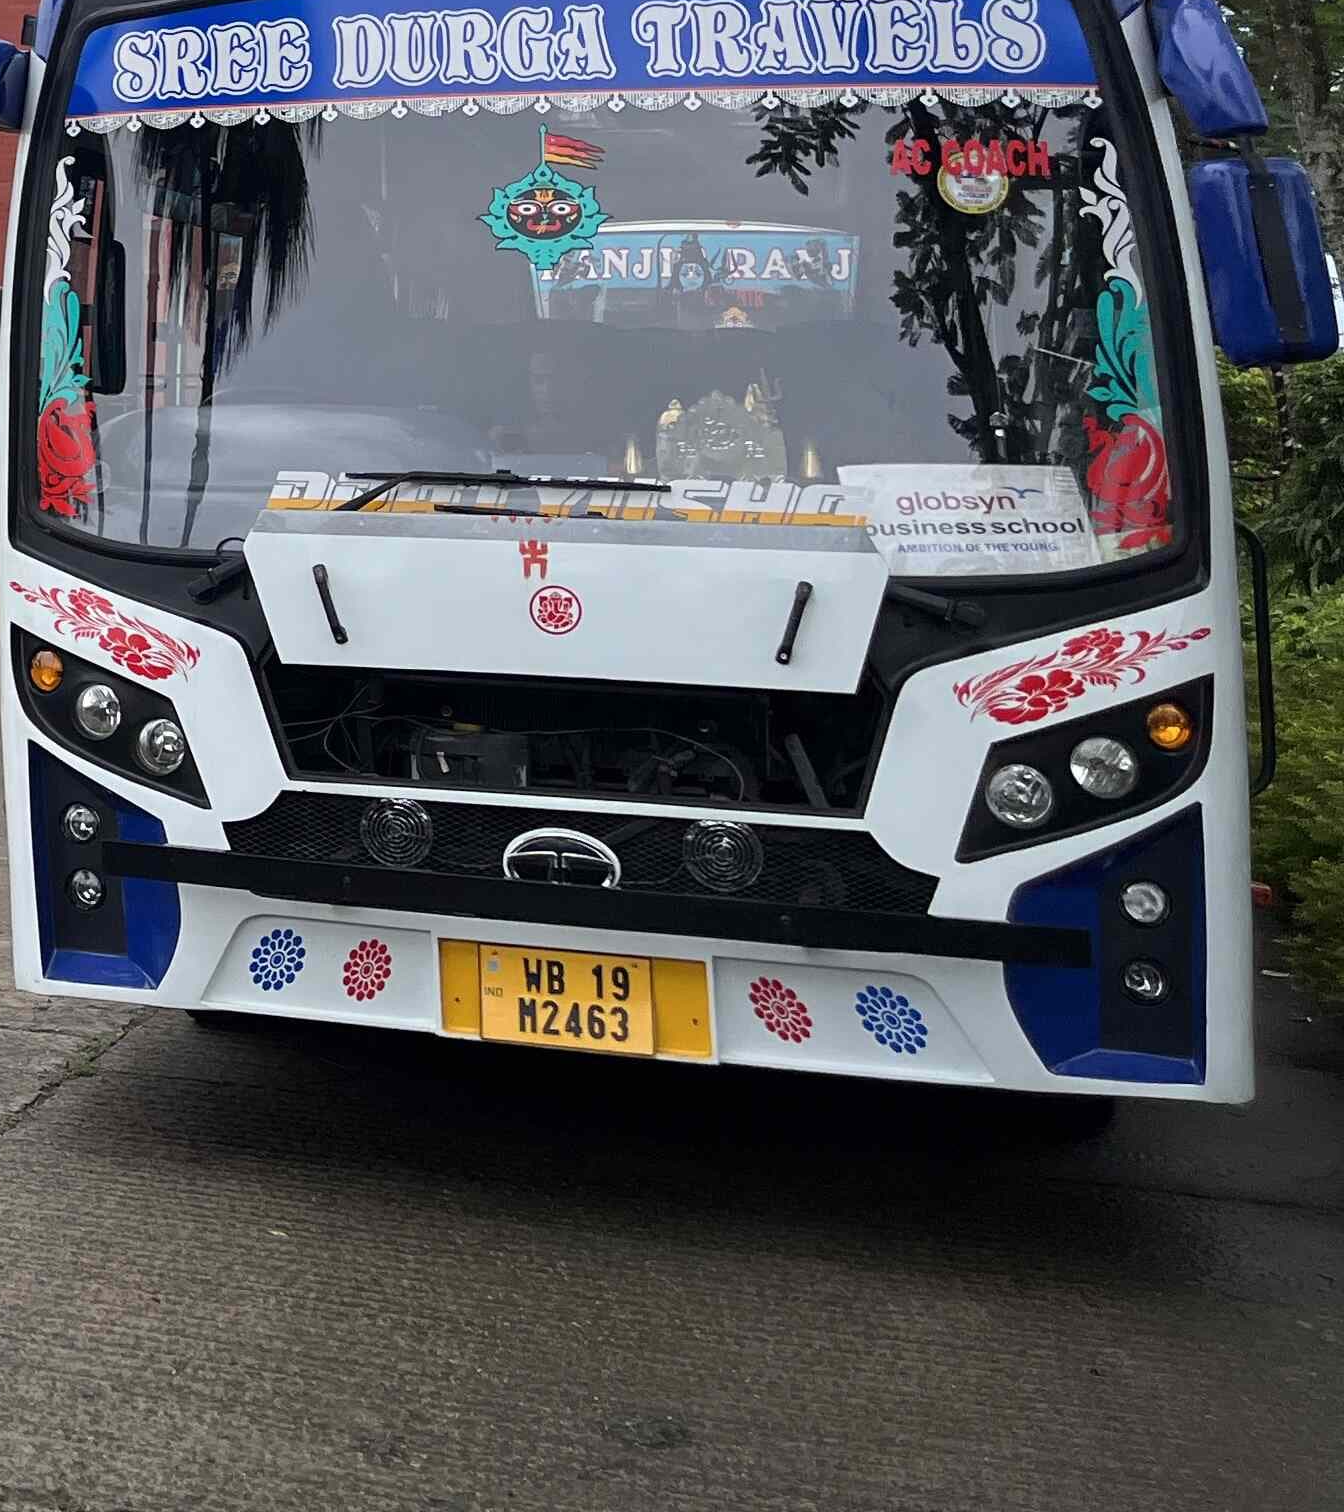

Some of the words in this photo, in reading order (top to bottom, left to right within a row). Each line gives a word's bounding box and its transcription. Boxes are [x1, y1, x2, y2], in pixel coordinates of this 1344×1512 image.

[113, 17, 312, 104] SREE
[332, 4, 616, 89] DURGA
[890, 138, 933, 176] AC
[941, 138, 1052, 179] COACH
[896, 491, 1017, 516] globsyn
[992, 517, 1086, 536] school
[897, 542, 962, 554] AMBITION
[965, 543, 981, 553] OF
[984, 542, 1010, 553] THE
[1011, 541, 1058, 553] YOUNG
[483, 986, 505, 999] IND
[522, 957, 566, 996] WB
[591, 963, 631, 1002] 19
[517, 996, 630, 1043] M2463
